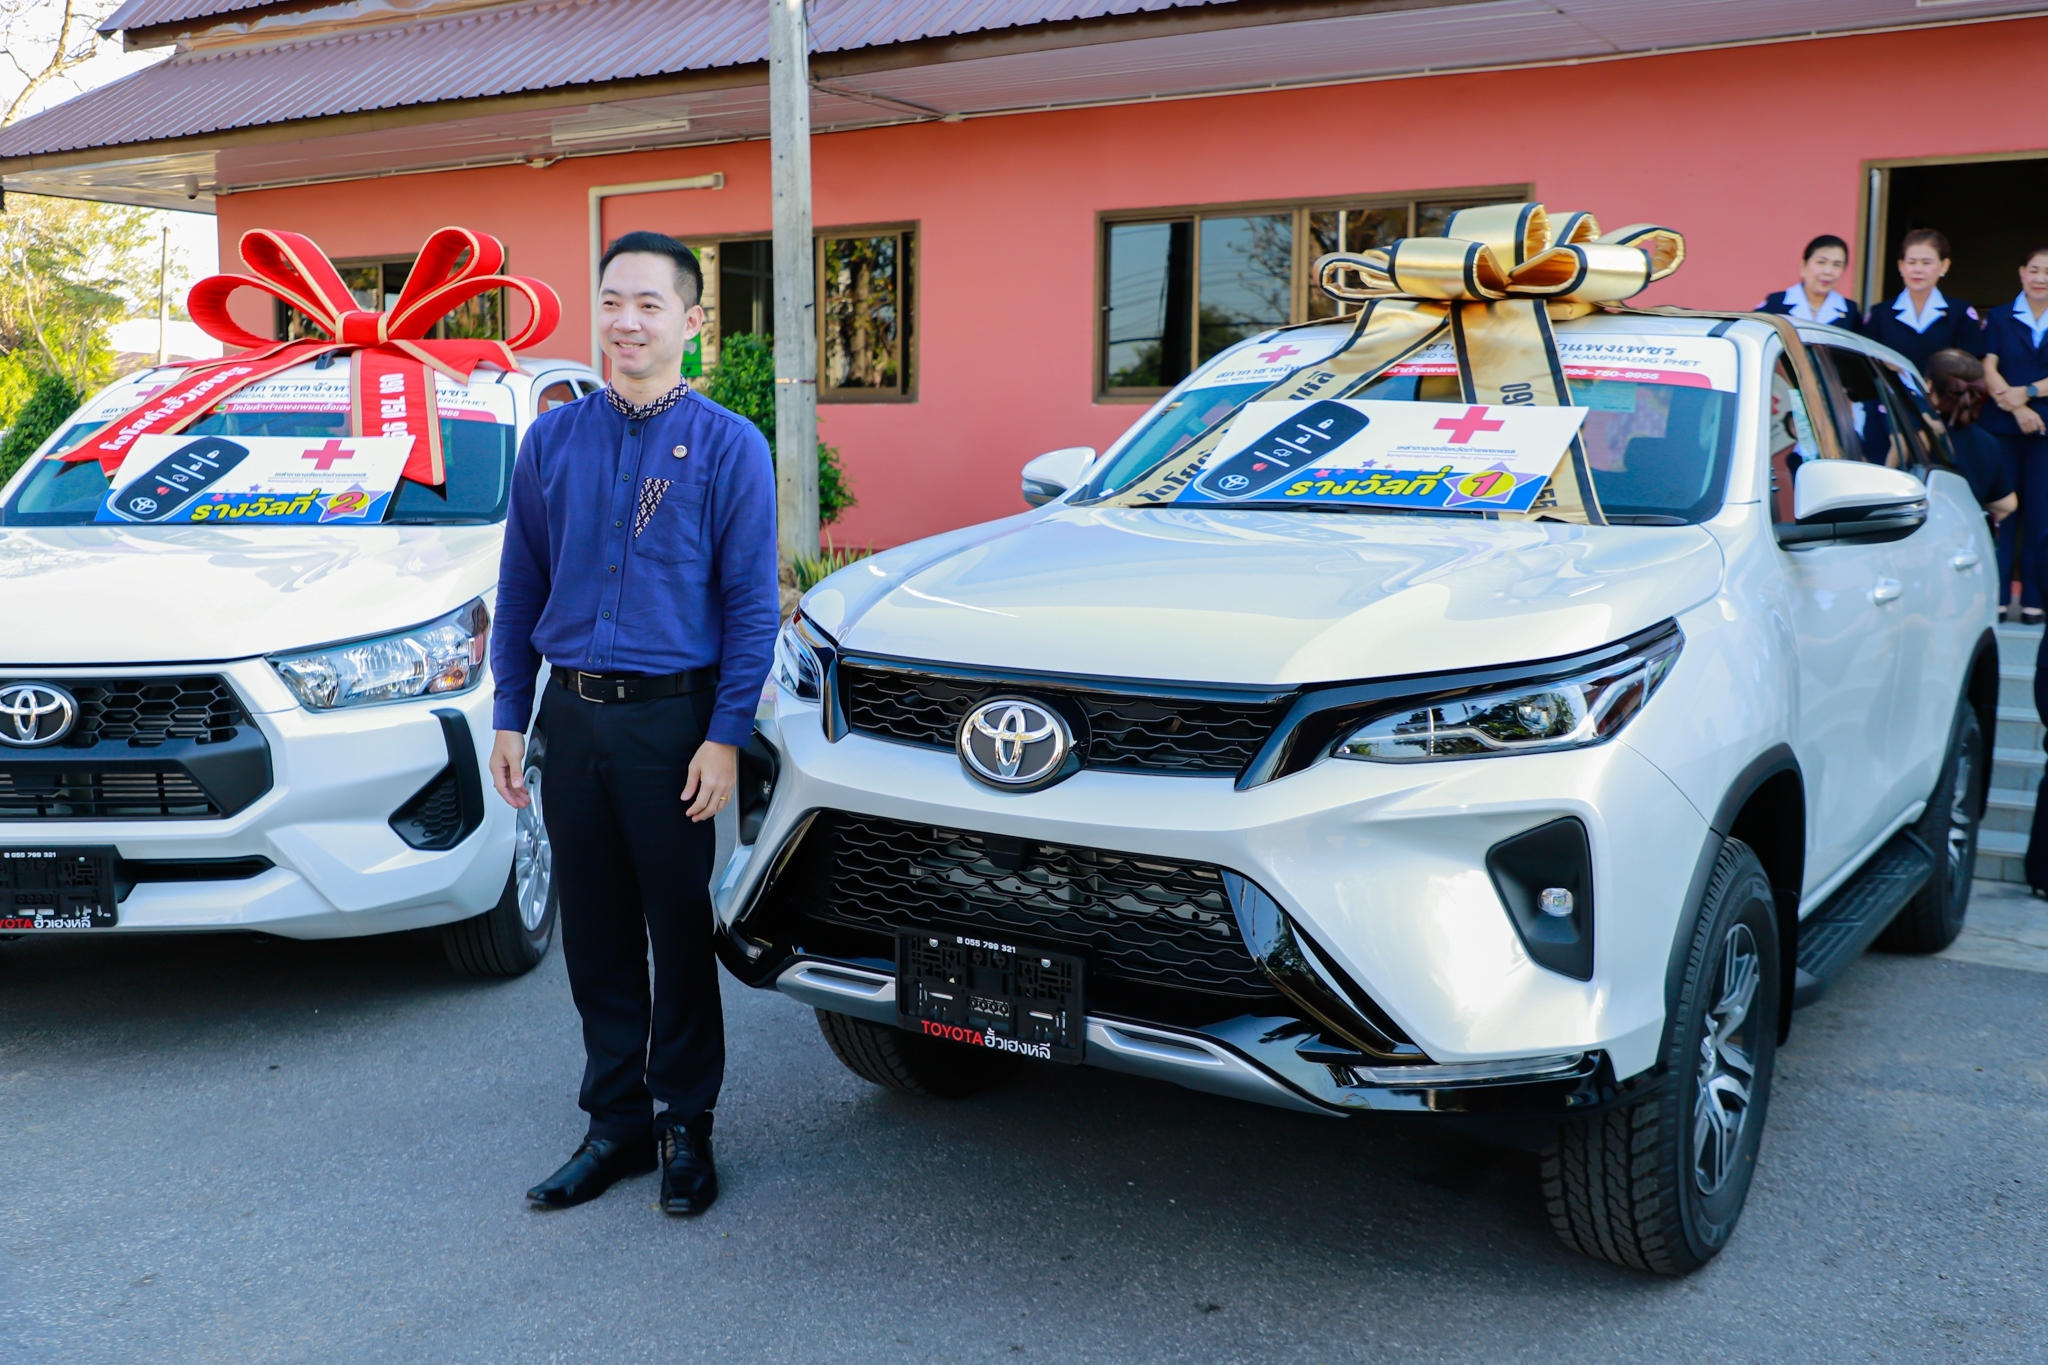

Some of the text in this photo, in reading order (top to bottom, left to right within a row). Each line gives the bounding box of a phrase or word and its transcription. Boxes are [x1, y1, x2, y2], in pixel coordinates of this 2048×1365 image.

[1572, 353, 1660, 365] KAMPHAENG
[1663, 358, 1702, 367] PHET
[1500, 382, 1536, 406] 09
[382, 421, 409, 438] 99
[1284, 465, 1504, 497] รางวัลที่ 1
[190, 488, 364, 521] รางวัลที่ 2
[0, 918, 34, 929] YOTA
[964, 937, 1016, 953] 055 799 321
